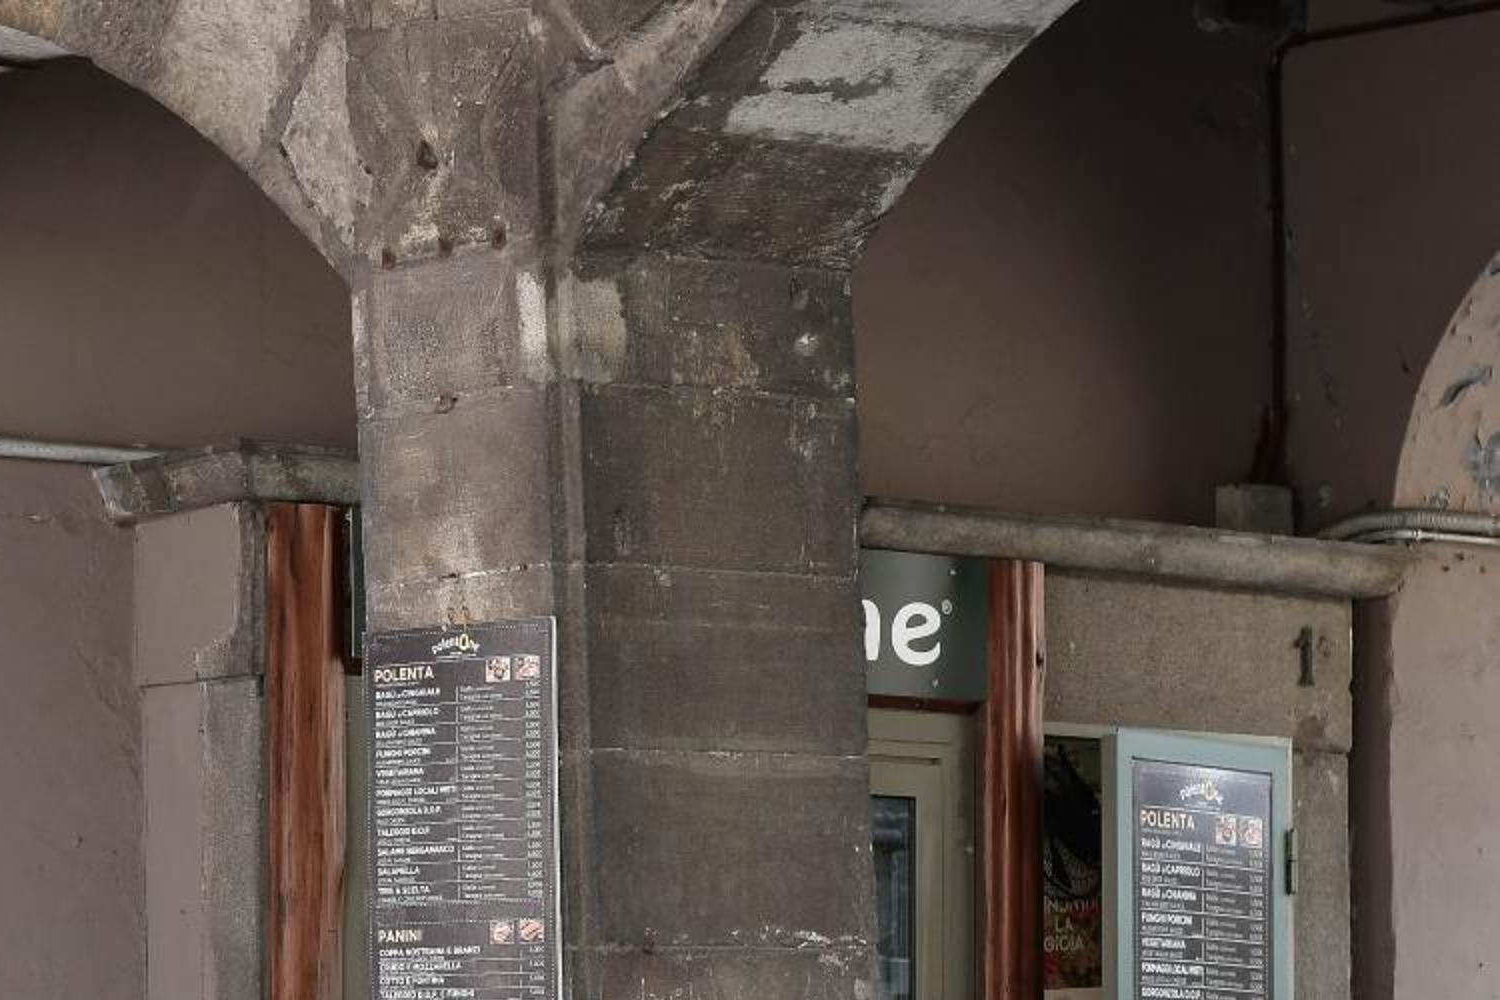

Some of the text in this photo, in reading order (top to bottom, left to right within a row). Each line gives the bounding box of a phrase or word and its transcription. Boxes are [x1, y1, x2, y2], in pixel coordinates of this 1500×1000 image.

[374, 665, 435, 683] POLENTA
[1140, 810, 1196, 831] POLENTA
[378, 929, 423, 944] PANINI
